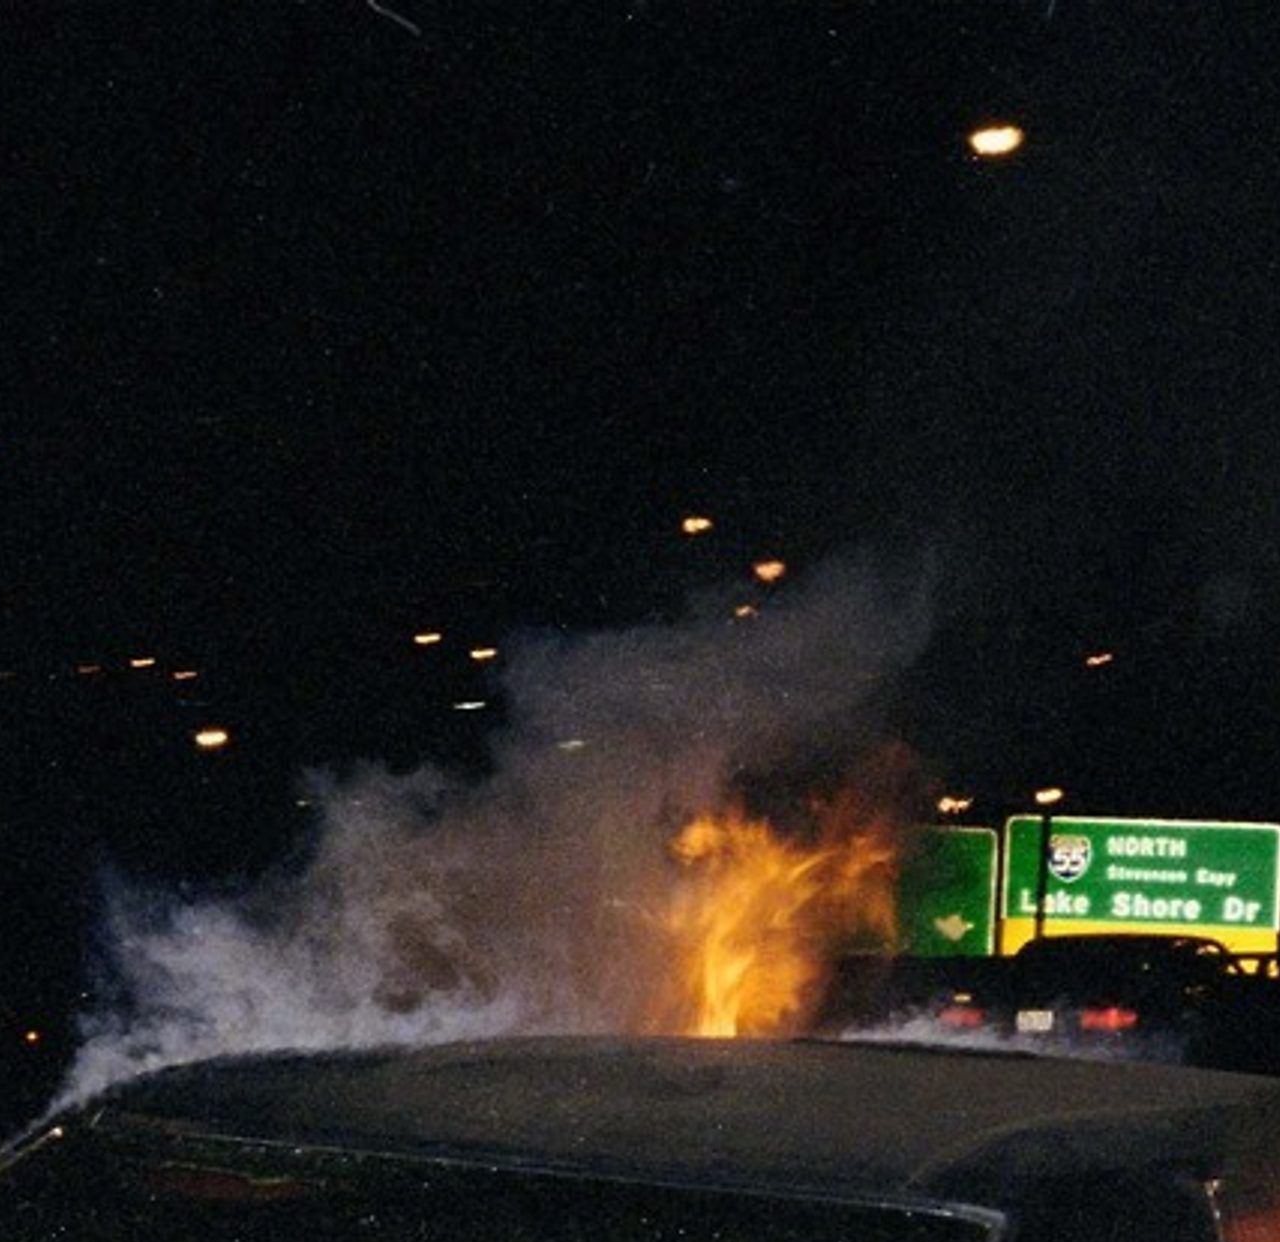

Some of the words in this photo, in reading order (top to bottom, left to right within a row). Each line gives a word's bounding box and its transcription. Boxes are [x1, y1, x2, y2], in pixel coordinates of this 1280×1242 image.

[1053, 847, 1085, 872] 55
[1107, 837, 1186, 857] NORTH
[1111, 891, 1202, 920] Shore
[1223, 895, 1261, 922] Dr
